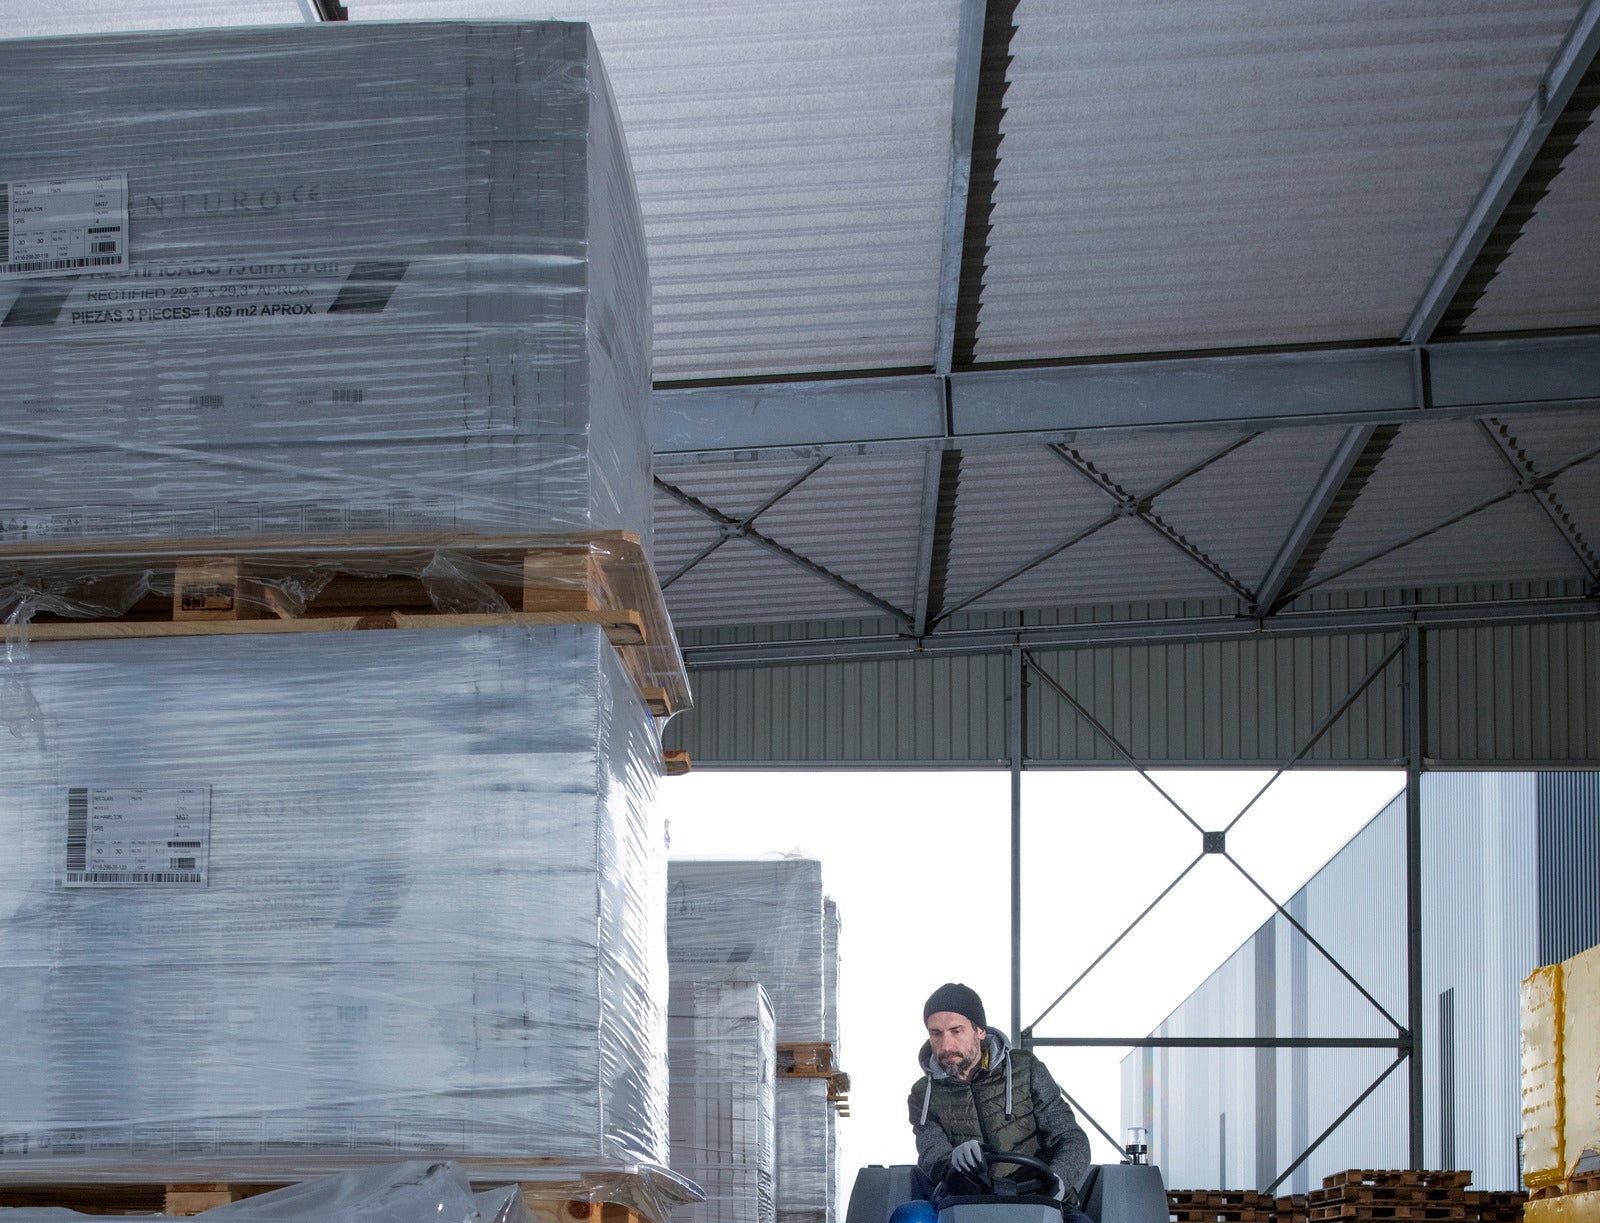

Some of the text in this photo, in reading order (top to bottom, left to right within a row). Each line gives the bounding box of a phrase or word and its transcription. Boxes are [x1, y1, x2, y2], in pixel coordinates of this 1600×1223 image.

[128, 189, 281, 214] NTURO
[87, 287, 166, 301] RECTIFIED
[72, 309, 122, 324] PIEZAS
[127, 309, 135, 322] 3
[139, 307, 200, 321] PIECES=
[236, 305, 257, 317] m2
[260, 303, 317, 316] APROX.
